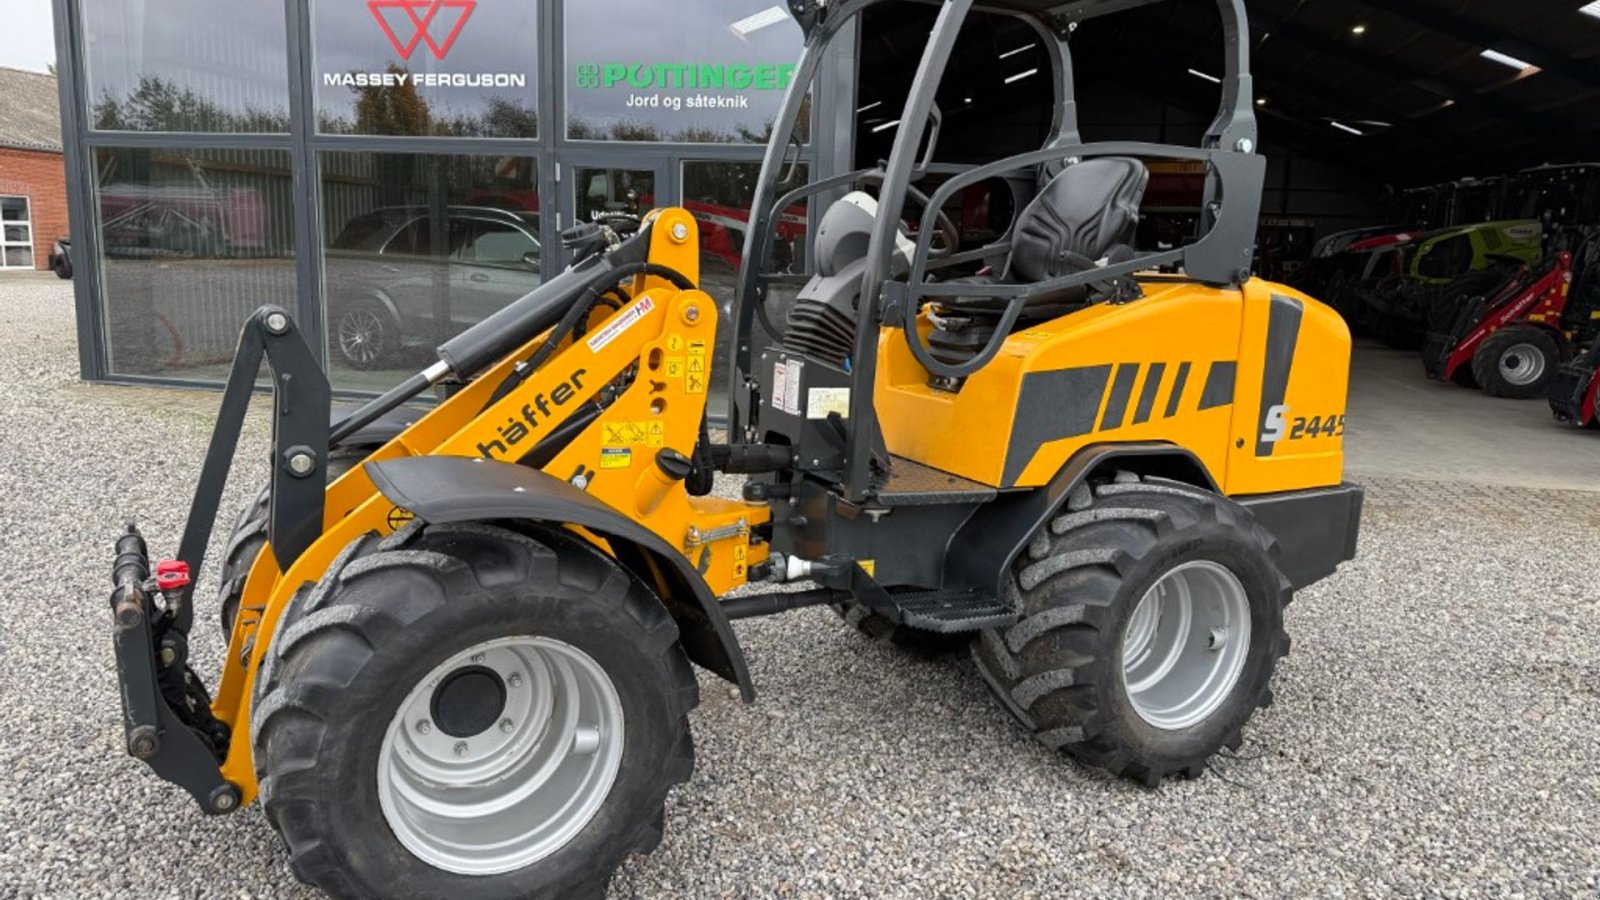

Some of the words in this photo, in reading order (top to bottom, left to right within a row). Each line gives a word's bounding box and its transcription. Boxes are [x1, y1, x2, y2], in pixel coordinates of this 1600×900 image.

[323, 73, 408, 87] MASSEY
[412, 73, 526, 87] FERGUSON
[626, 93, 659, 107] Jord
[663, 96, 681, 111] og
[686, 93, 748, 108] såteknik
[1260, 404, 1290, 442] S
[1289, 414, 1345, 440] 2445
